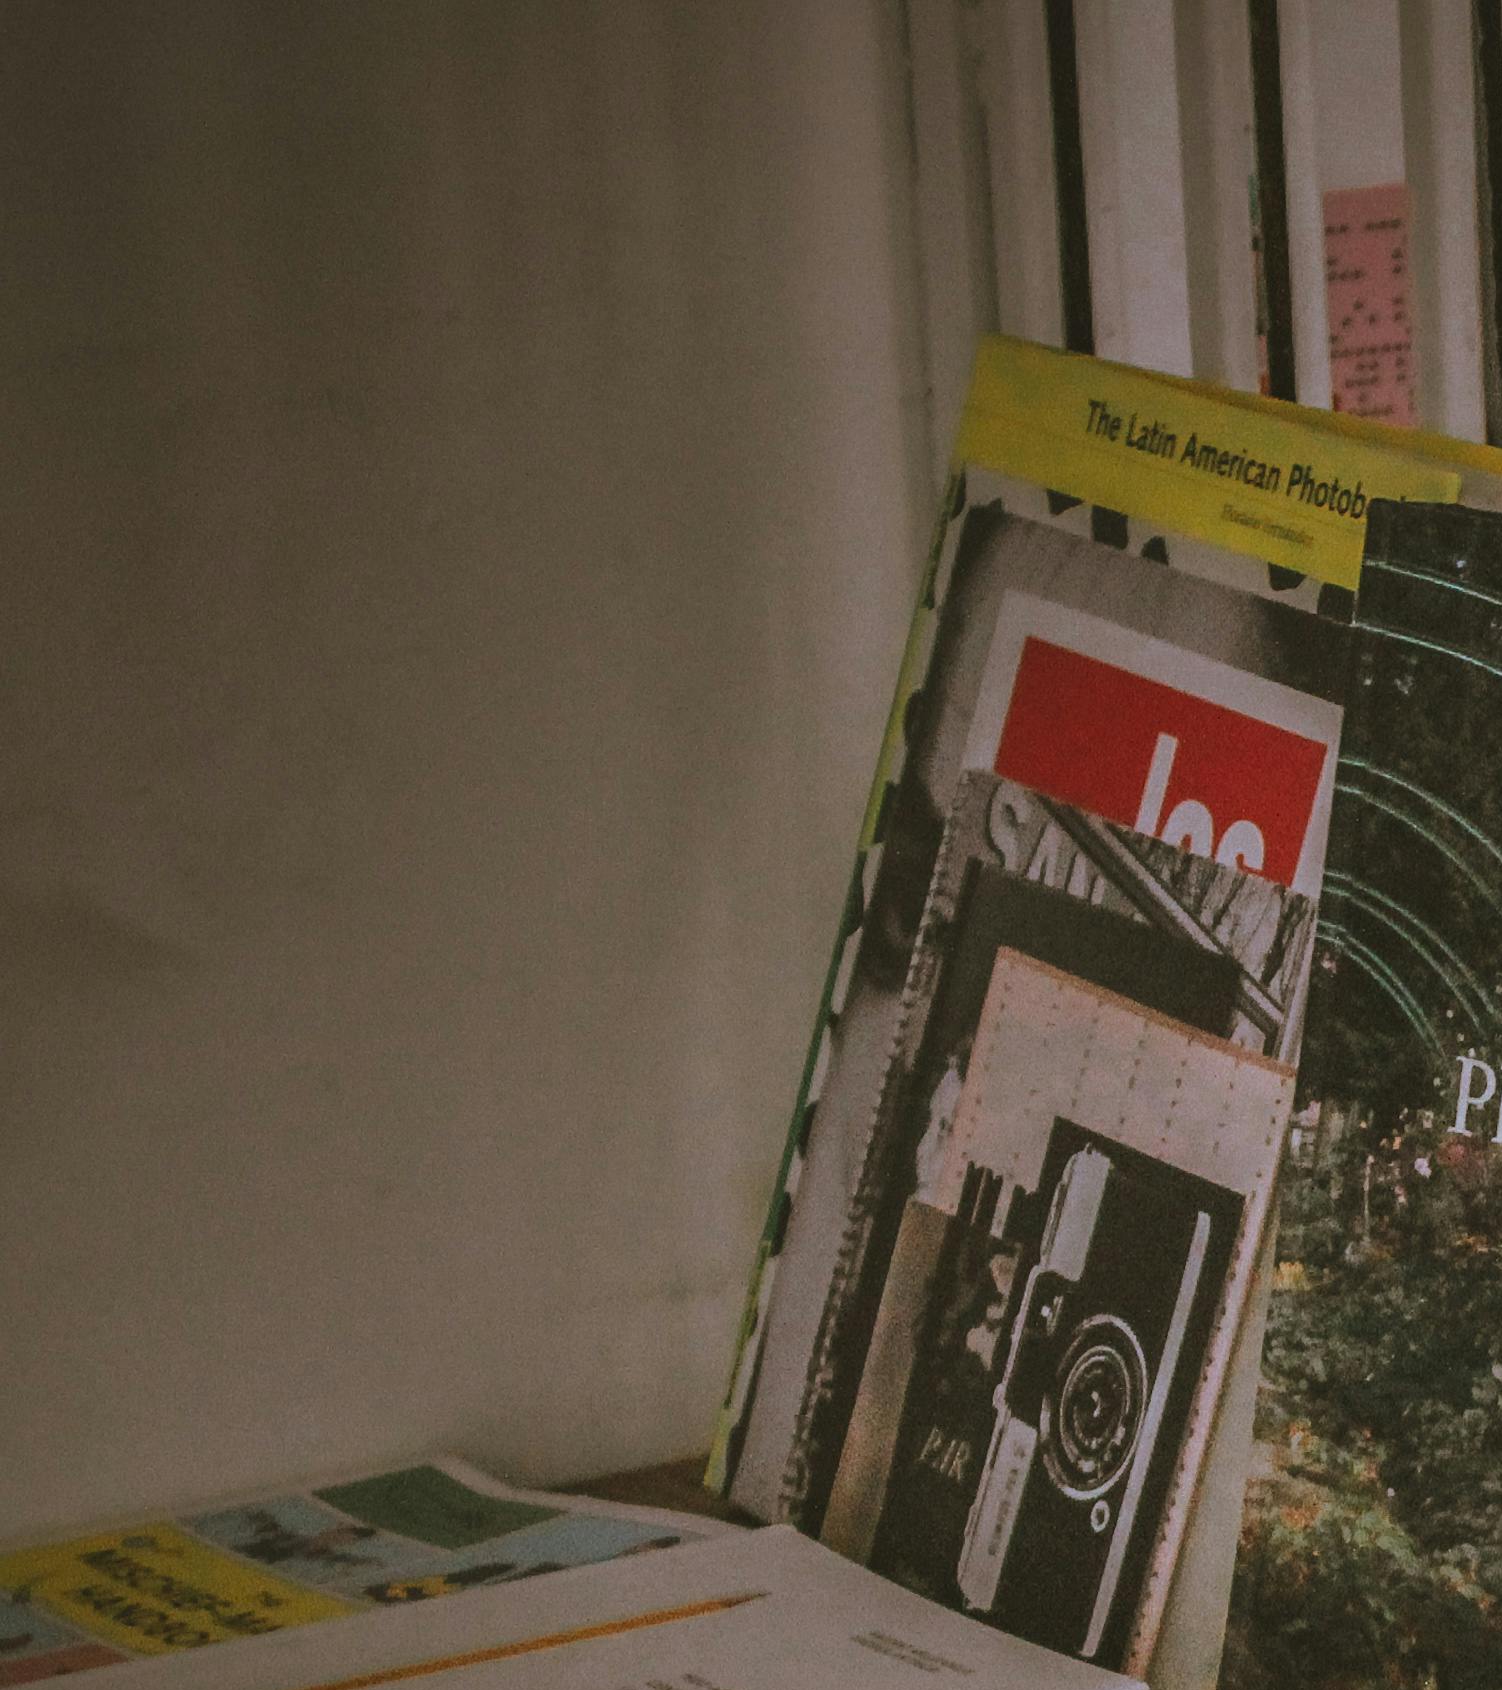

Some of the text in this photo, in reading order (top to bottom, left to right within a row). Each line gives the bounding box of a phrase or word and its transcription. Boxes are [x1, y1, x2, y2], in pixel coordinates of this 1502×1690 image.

[1086, 399, 1122, 440] The
[1126, 412, 1177, 458] Latin
[1180, 430, 1281, 495] American
